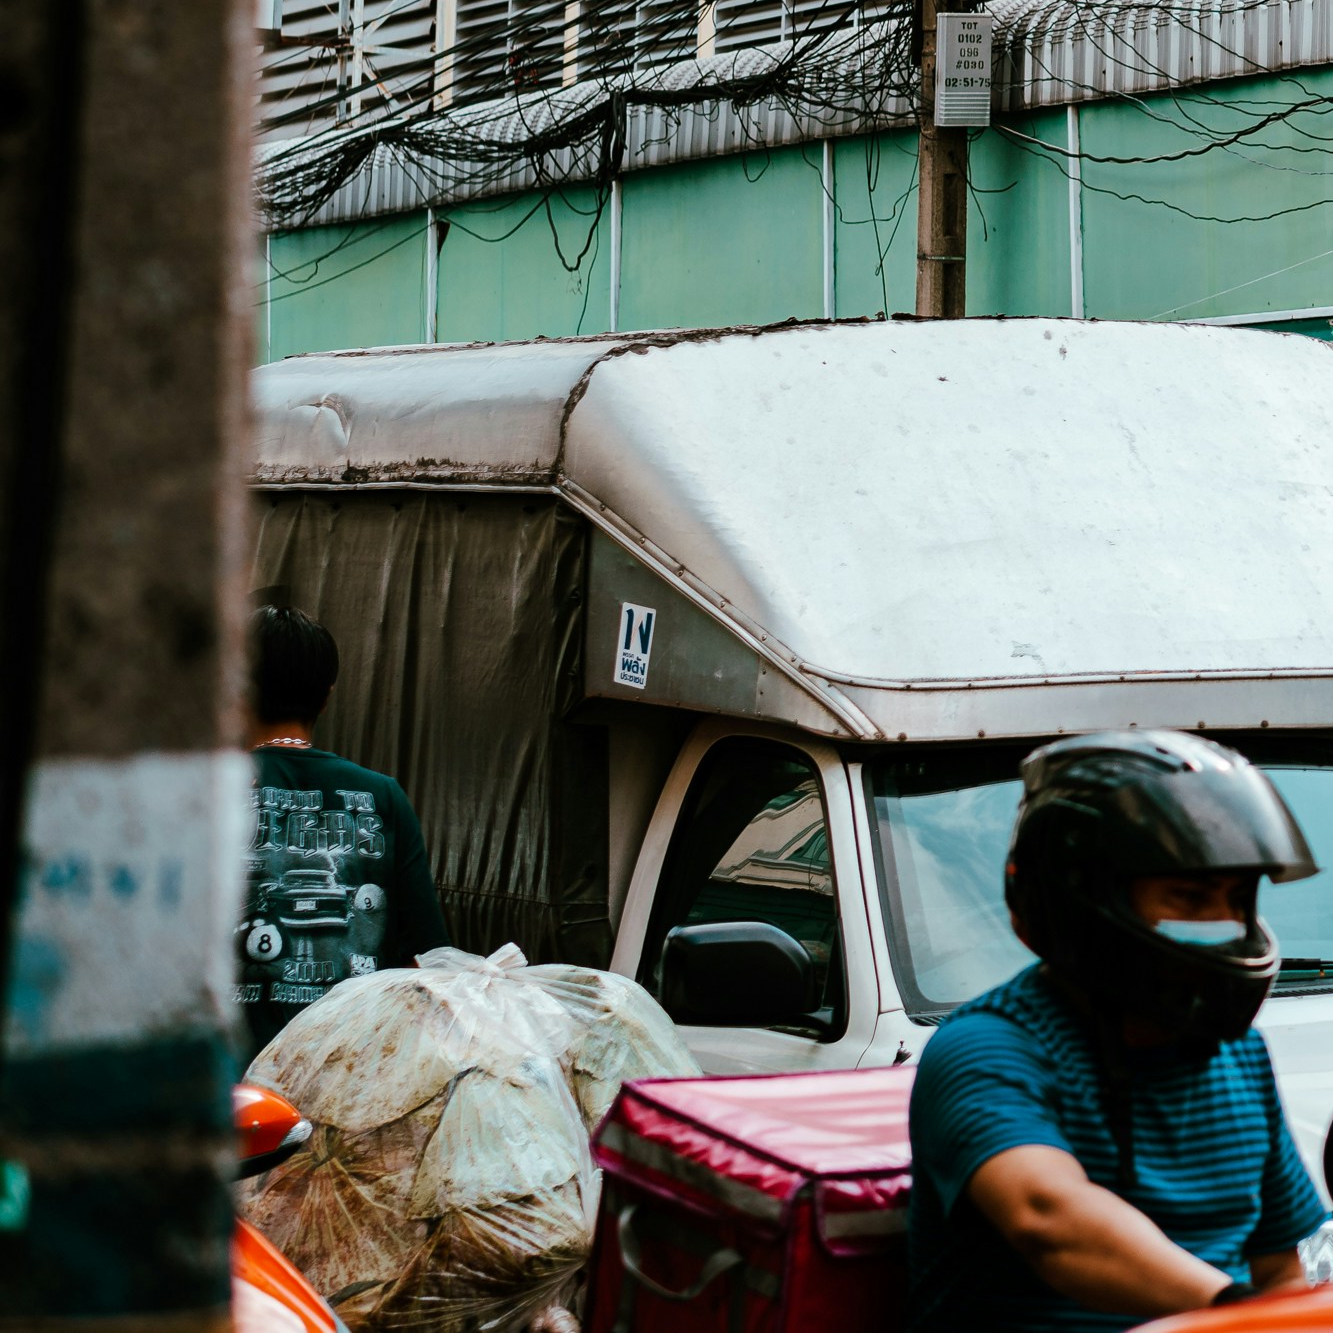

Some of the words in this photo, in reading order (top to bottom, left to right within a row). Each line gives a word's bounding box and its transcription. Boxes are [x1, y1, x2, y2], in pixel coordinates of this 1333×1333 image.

[961, 22, 978, 30] TOT
[957, 34, 982, 44] 0102
[621, 656, 646, 676] พลัง
[364, 897, 374, 912] 9
[258, 934, 272, 954] 8
